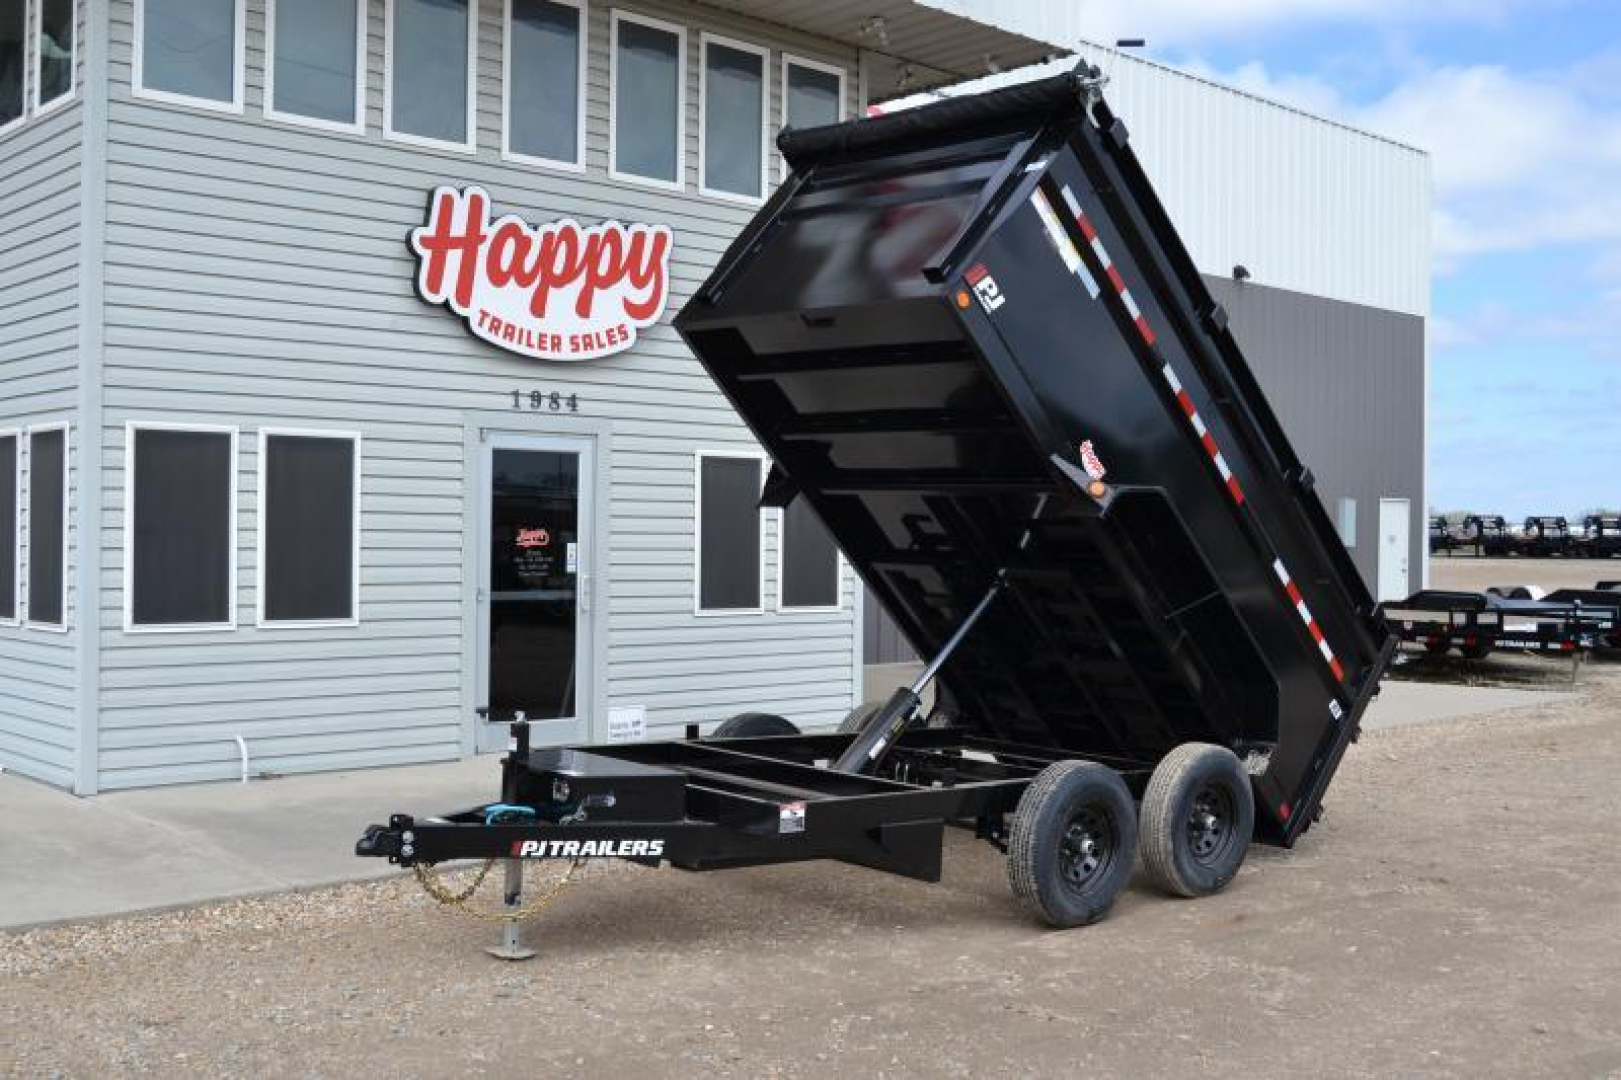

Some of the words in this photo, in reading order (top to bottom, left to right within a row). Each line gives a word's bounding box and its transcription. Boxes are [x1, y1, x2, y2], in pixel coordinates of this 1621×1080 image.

[418, 193, 668, 321] Happy
[478, 308, 563, 353] TRAILER
[568, 323, 630, 353] SALES
[511, 389, 579, 412] 1984
